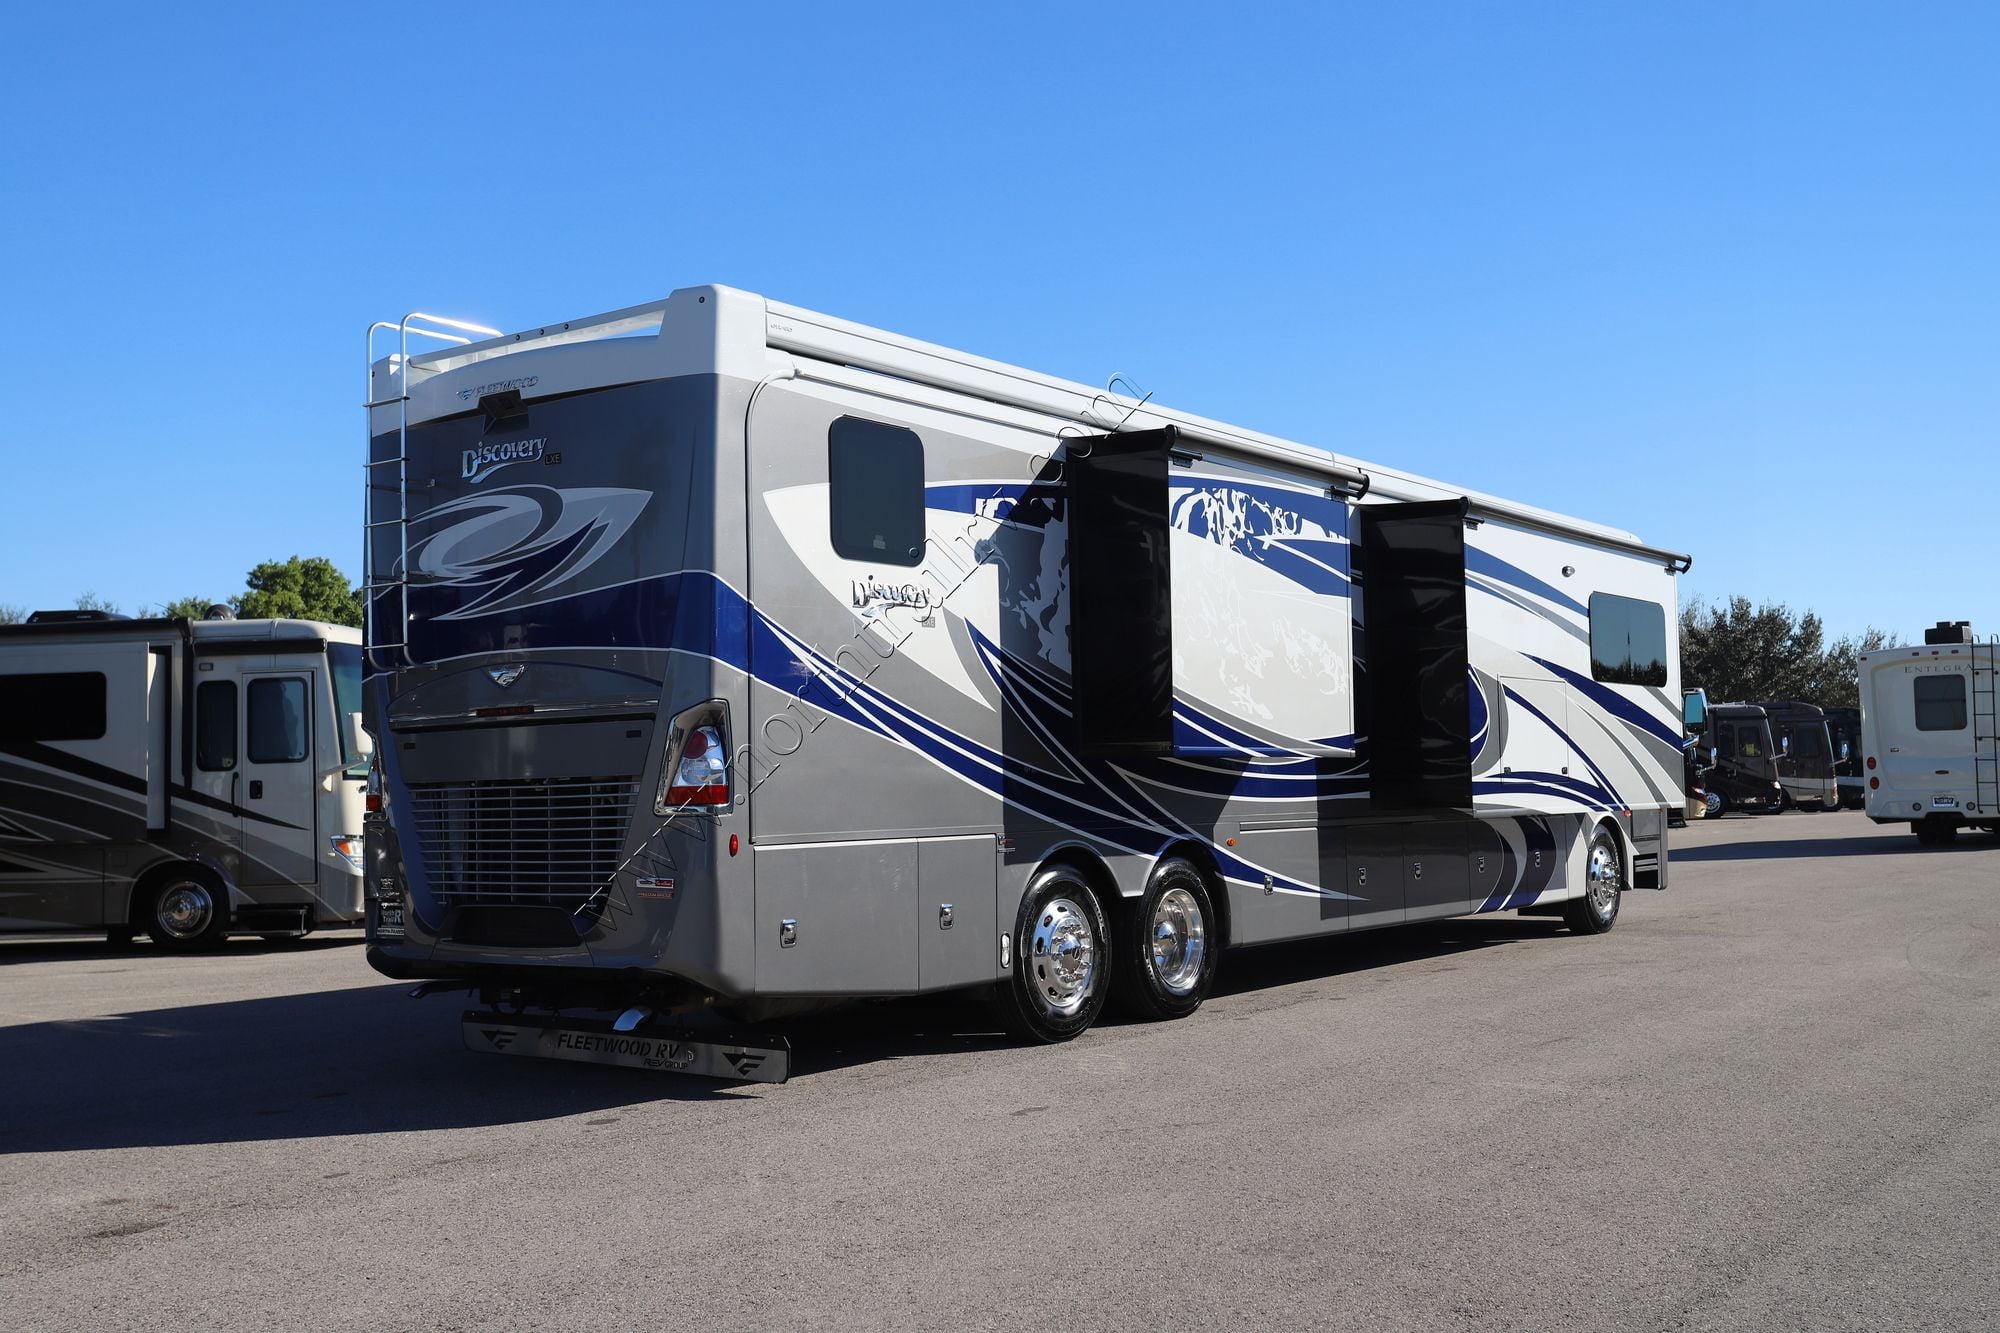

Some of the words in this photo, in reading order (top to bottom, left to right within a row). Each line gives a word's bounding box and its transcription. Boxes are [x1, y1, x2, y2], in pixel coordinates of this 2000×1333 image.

[476, 375, 539, 397] FLEETWOOD
[462, 437, 547, 480] Discovery
[545, 453, 561, 464] LXE
[1904, 663, 1973, 674] ENTEGRA
[558, 1033, 651, 1057] FLEETWOOD
[655, 1042, 680, 1059] RV
